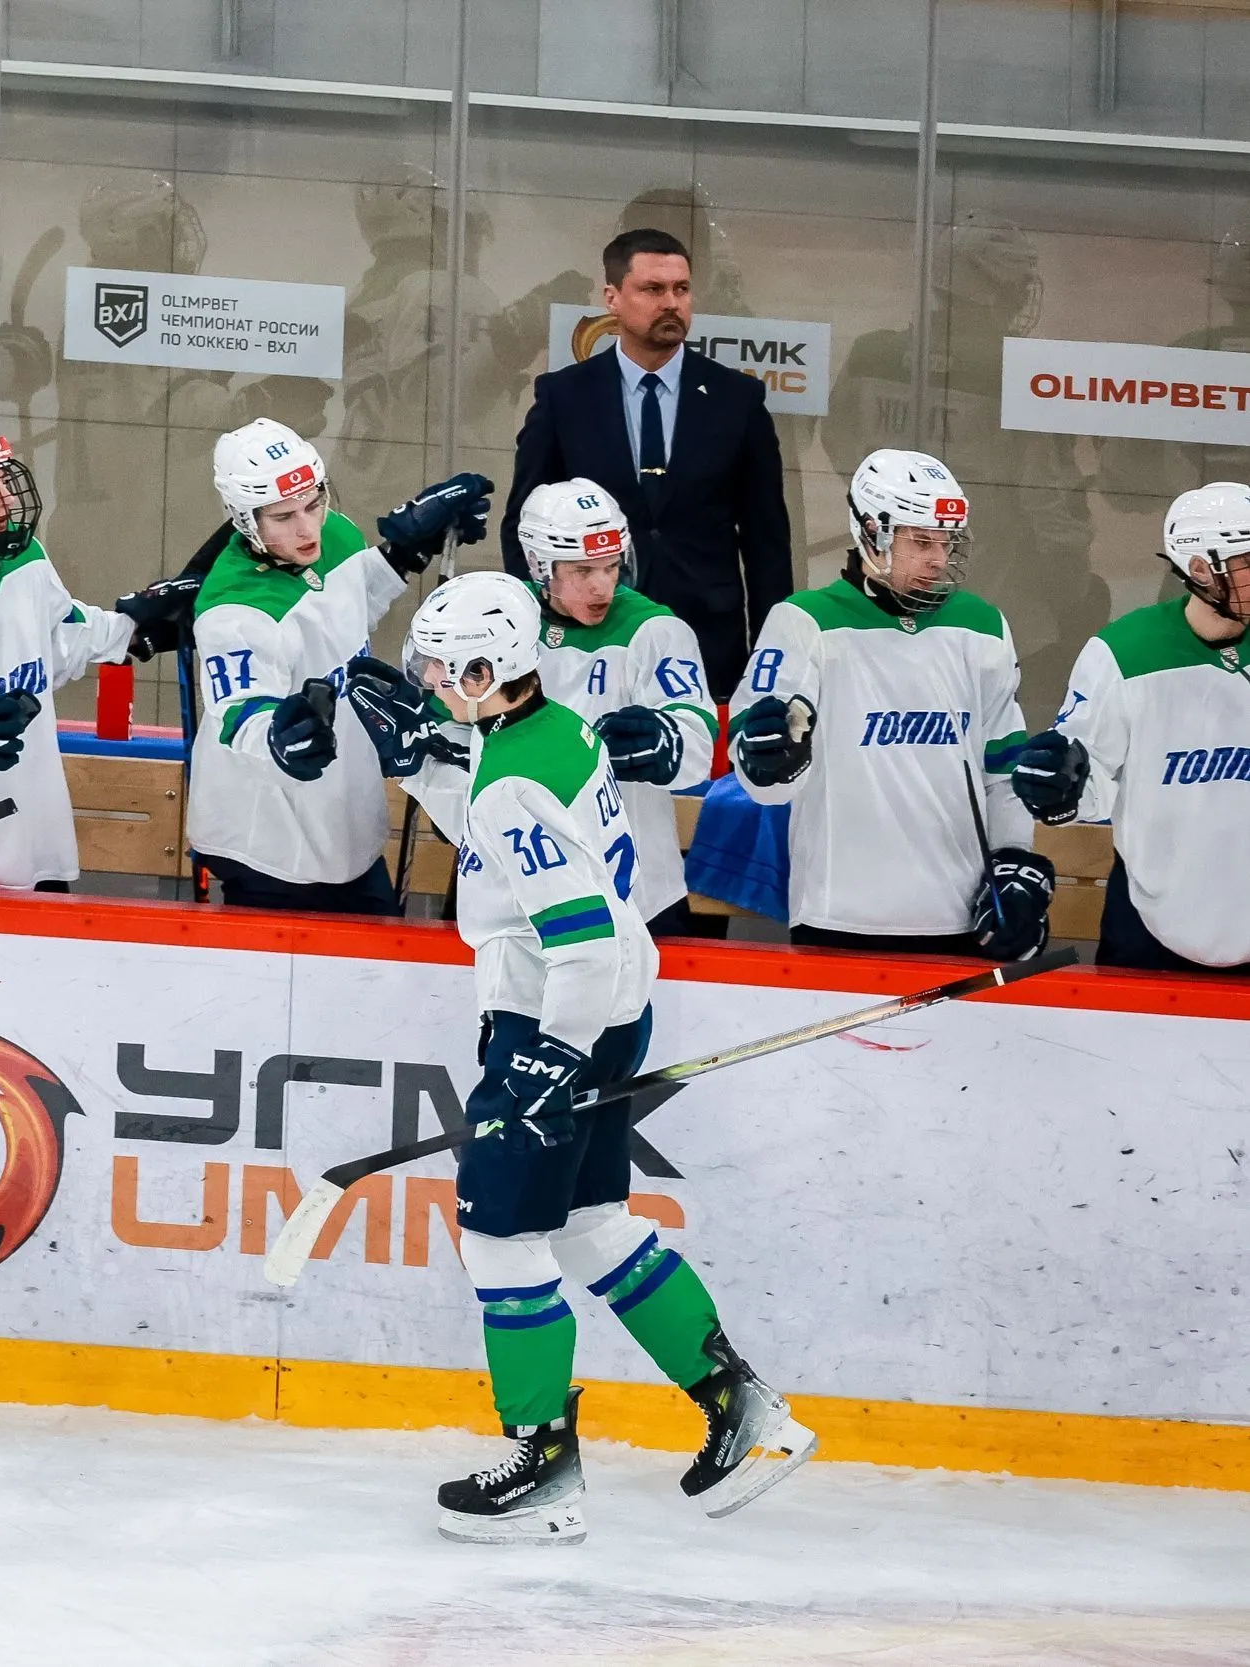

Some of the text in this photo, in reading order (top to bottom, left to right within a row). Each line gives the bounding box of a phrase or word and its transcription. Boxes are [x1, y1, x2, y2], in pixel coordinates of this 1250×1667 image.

[99, 302, 144, 325] ВХЛ
[161, 294, 239, 312] OLIMPBET
[161, 314, 319, 336] ЧЕМПИОНАТ РОССИИ
[160, 332, 181, 346] ПО
[186, 334, 249, 351] ХОККЕЮ
[267, 340, 298, 354] ВХЛ
[265, 441, 290, 460] 87
[577, 495, 601, 510] 67
[206, 649, 258, 704] 87
[587, 659, 608, 695] A
[713, 1428, 733, 1467] BAUER
[497, 1481, 536, 1506] BAUER
